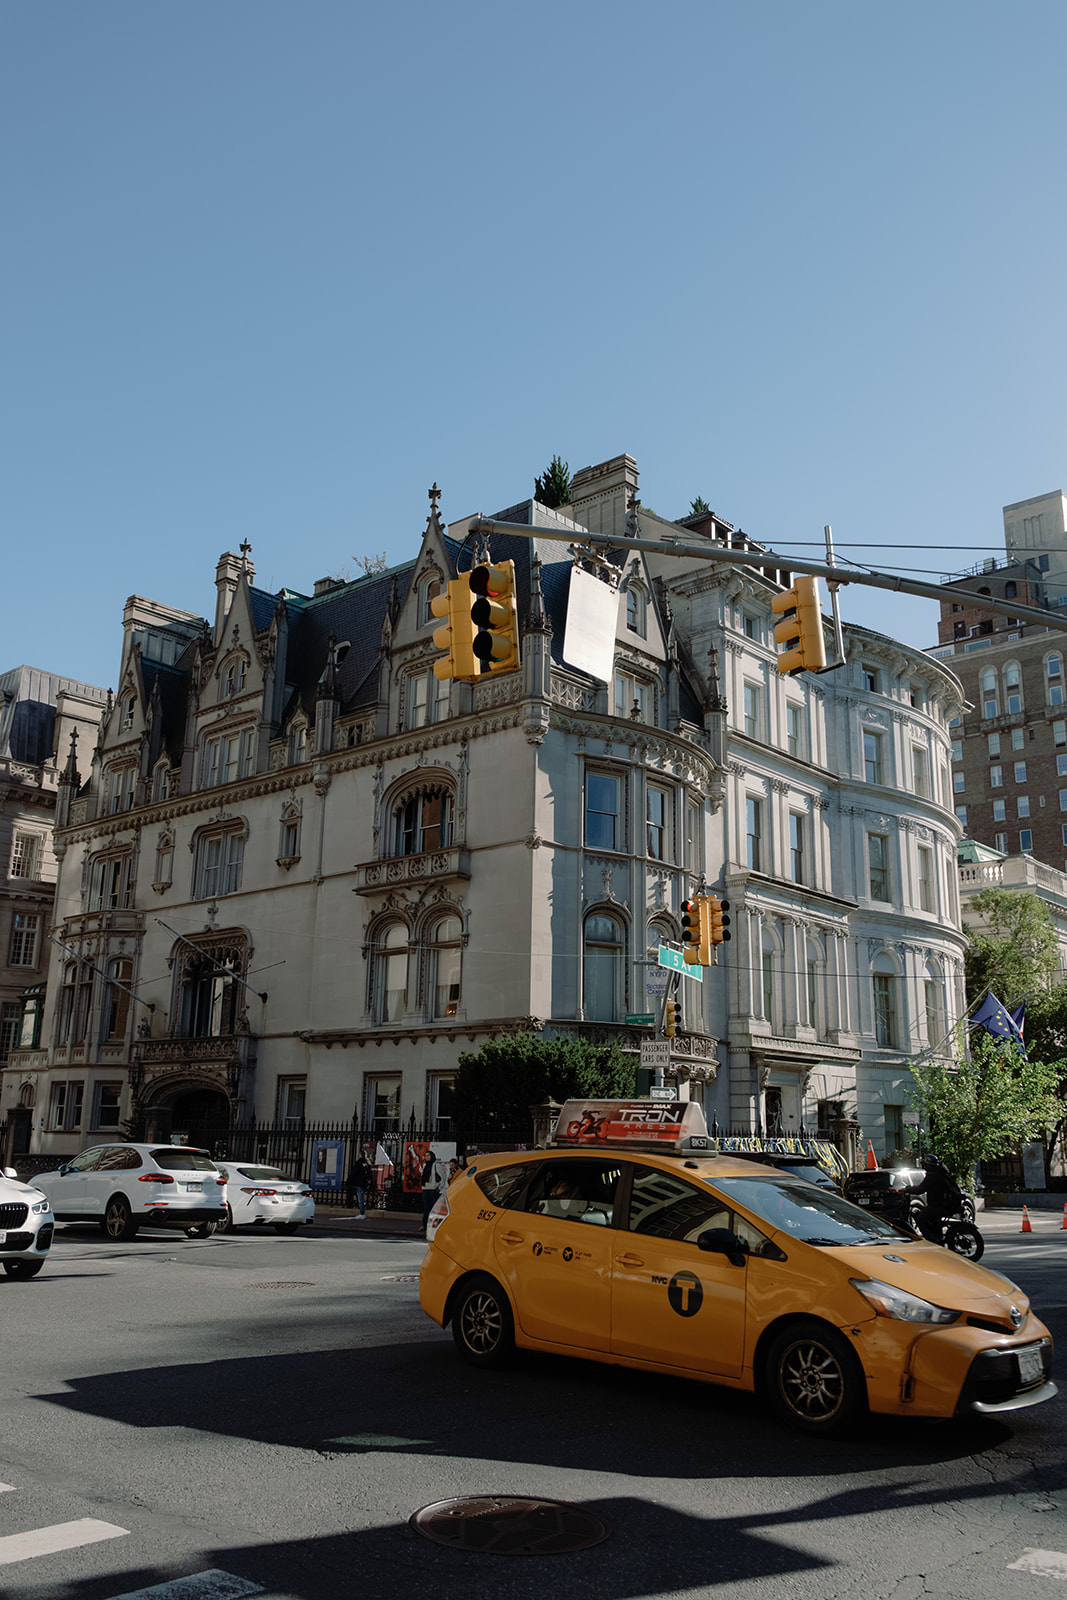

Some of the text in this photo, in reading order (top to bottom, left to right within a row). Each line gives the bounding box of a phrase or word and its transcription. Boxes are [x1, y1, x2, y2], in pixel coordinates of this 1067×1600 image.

[673, 955, 679, 967] 5
[642, 1044, 668, 1053] PASSENGER
[642, 1055, 668, 1063] CARS ONLY
[619, 1109, 680, 1122] TRON
[691, 1138, 707, 1148] 8K57
[651, 1275, 668, 1285] NYC
